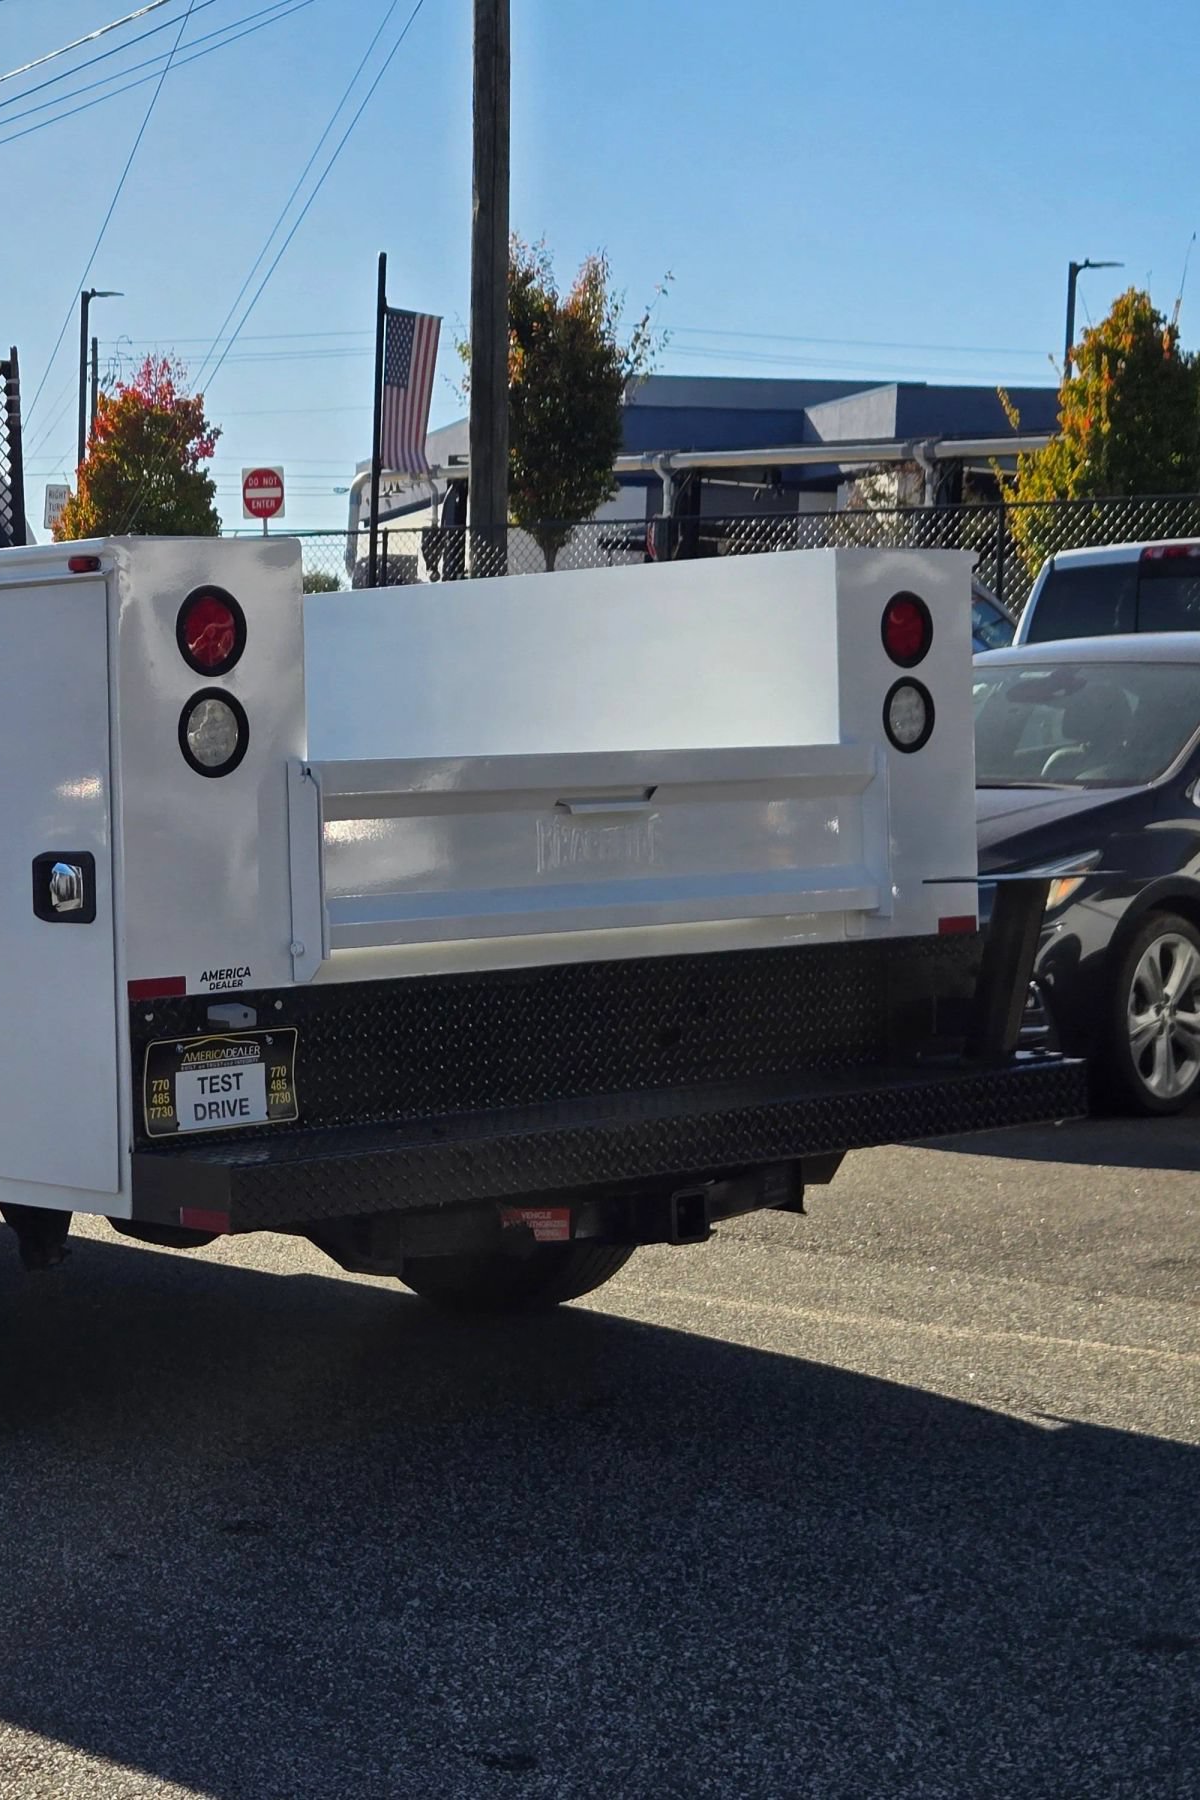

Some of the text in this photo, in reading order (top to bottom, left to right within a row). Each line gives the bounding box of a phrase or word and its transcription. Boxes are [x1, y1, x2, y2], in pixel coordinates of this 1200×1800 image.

[248, 476, 277, 487] DO NOT
[48, 490, 66, 500] RIGHT
[252, 499, 276, 509] ENTER
[200, 966, 251, 982] AMERICA
[209, 979, 243, 990] DEALER
[183, 1045, 260, 1062] AMERICADEALER
[270, 1065, 287, 1078] 770
[152, 1079, 170, 1092] 770
[197, 1072, 244, 1094] TEST
[270, 1079, 287, 1091] 485
[152, 1092, 170, 1105] 485
[269, 1091, 291, 1105] 7730
[150, 1105, 174, 1119] 7730
[193, 1097, 250, 1121] DRIVE
[520, 1211, 552, 1220] VEHICLE
